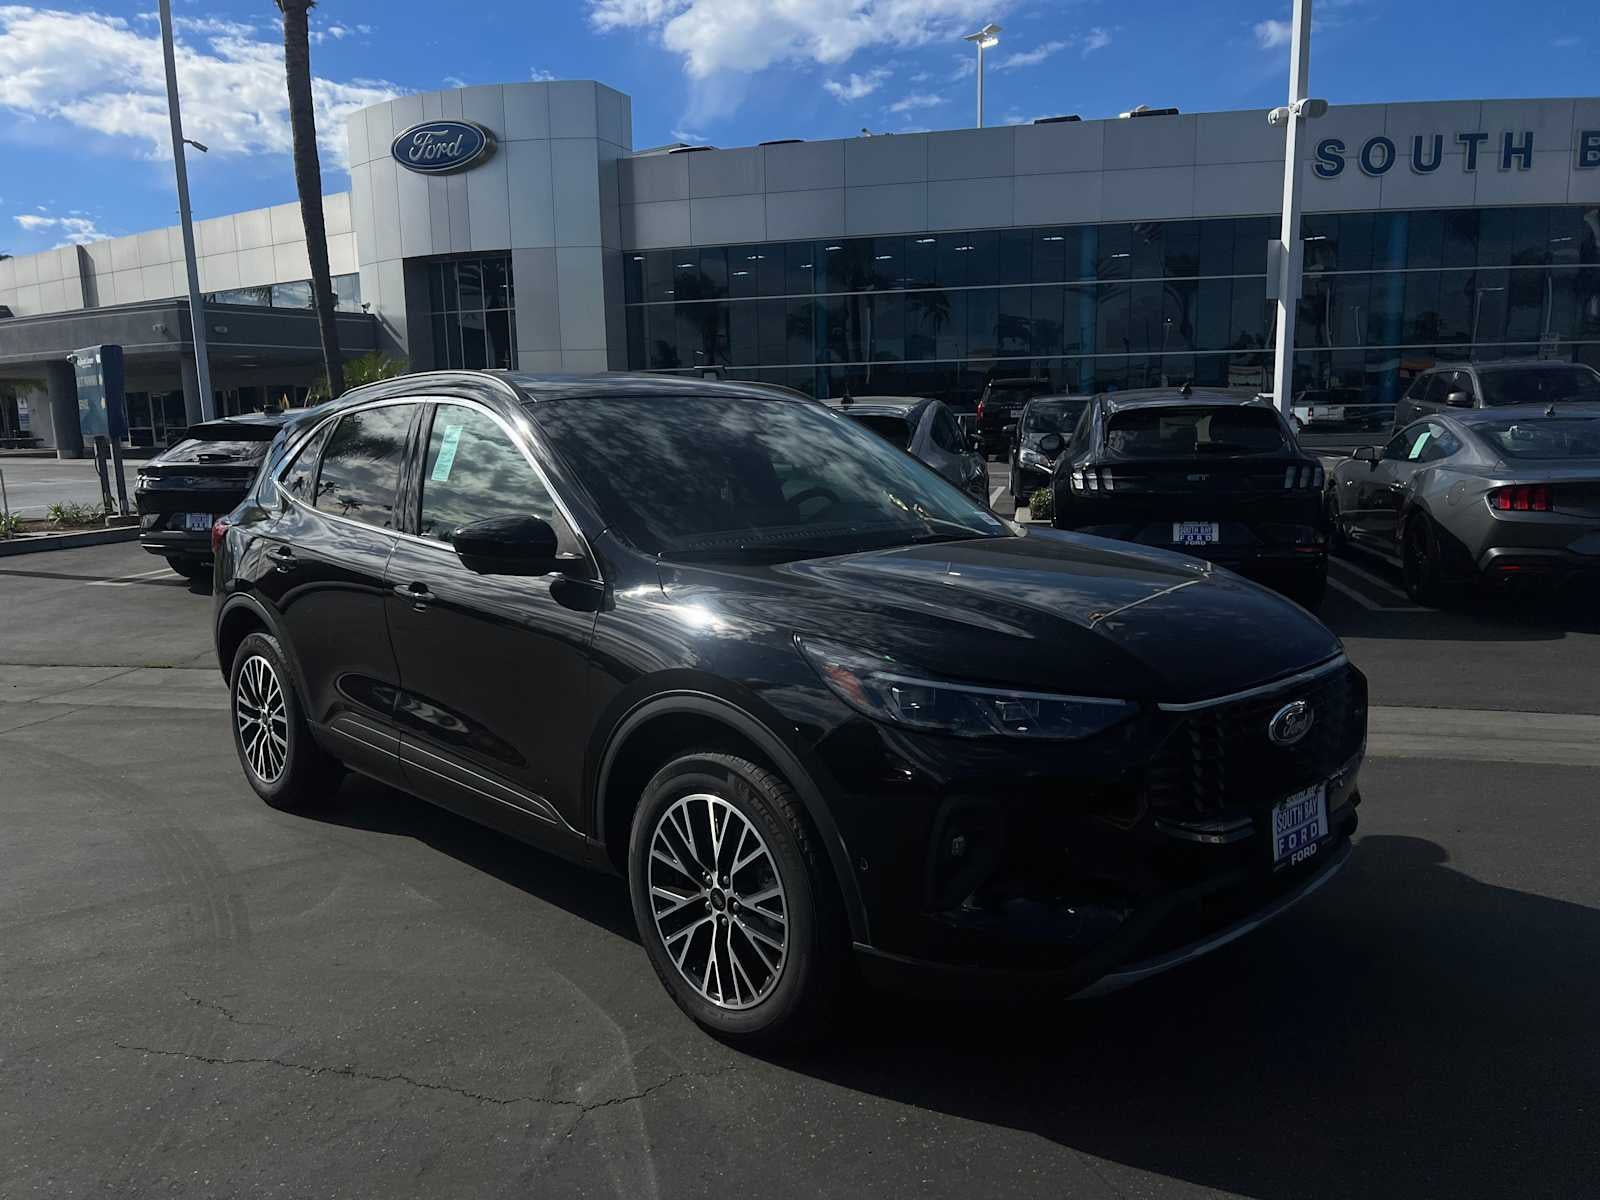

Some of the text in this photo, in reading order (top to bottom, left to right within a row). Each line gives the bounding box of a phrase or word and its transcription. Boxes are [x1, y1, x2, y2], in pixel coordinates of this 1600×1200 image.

[409, 129, 463, 160] Ford
[1313, 131, 1534, 178] SOUTH
[1277, 796, 1319, 833] SOUTH BAY
[1278, 822, 1318, 855] FORD
[1291, 843, 1317, 866] FORD
